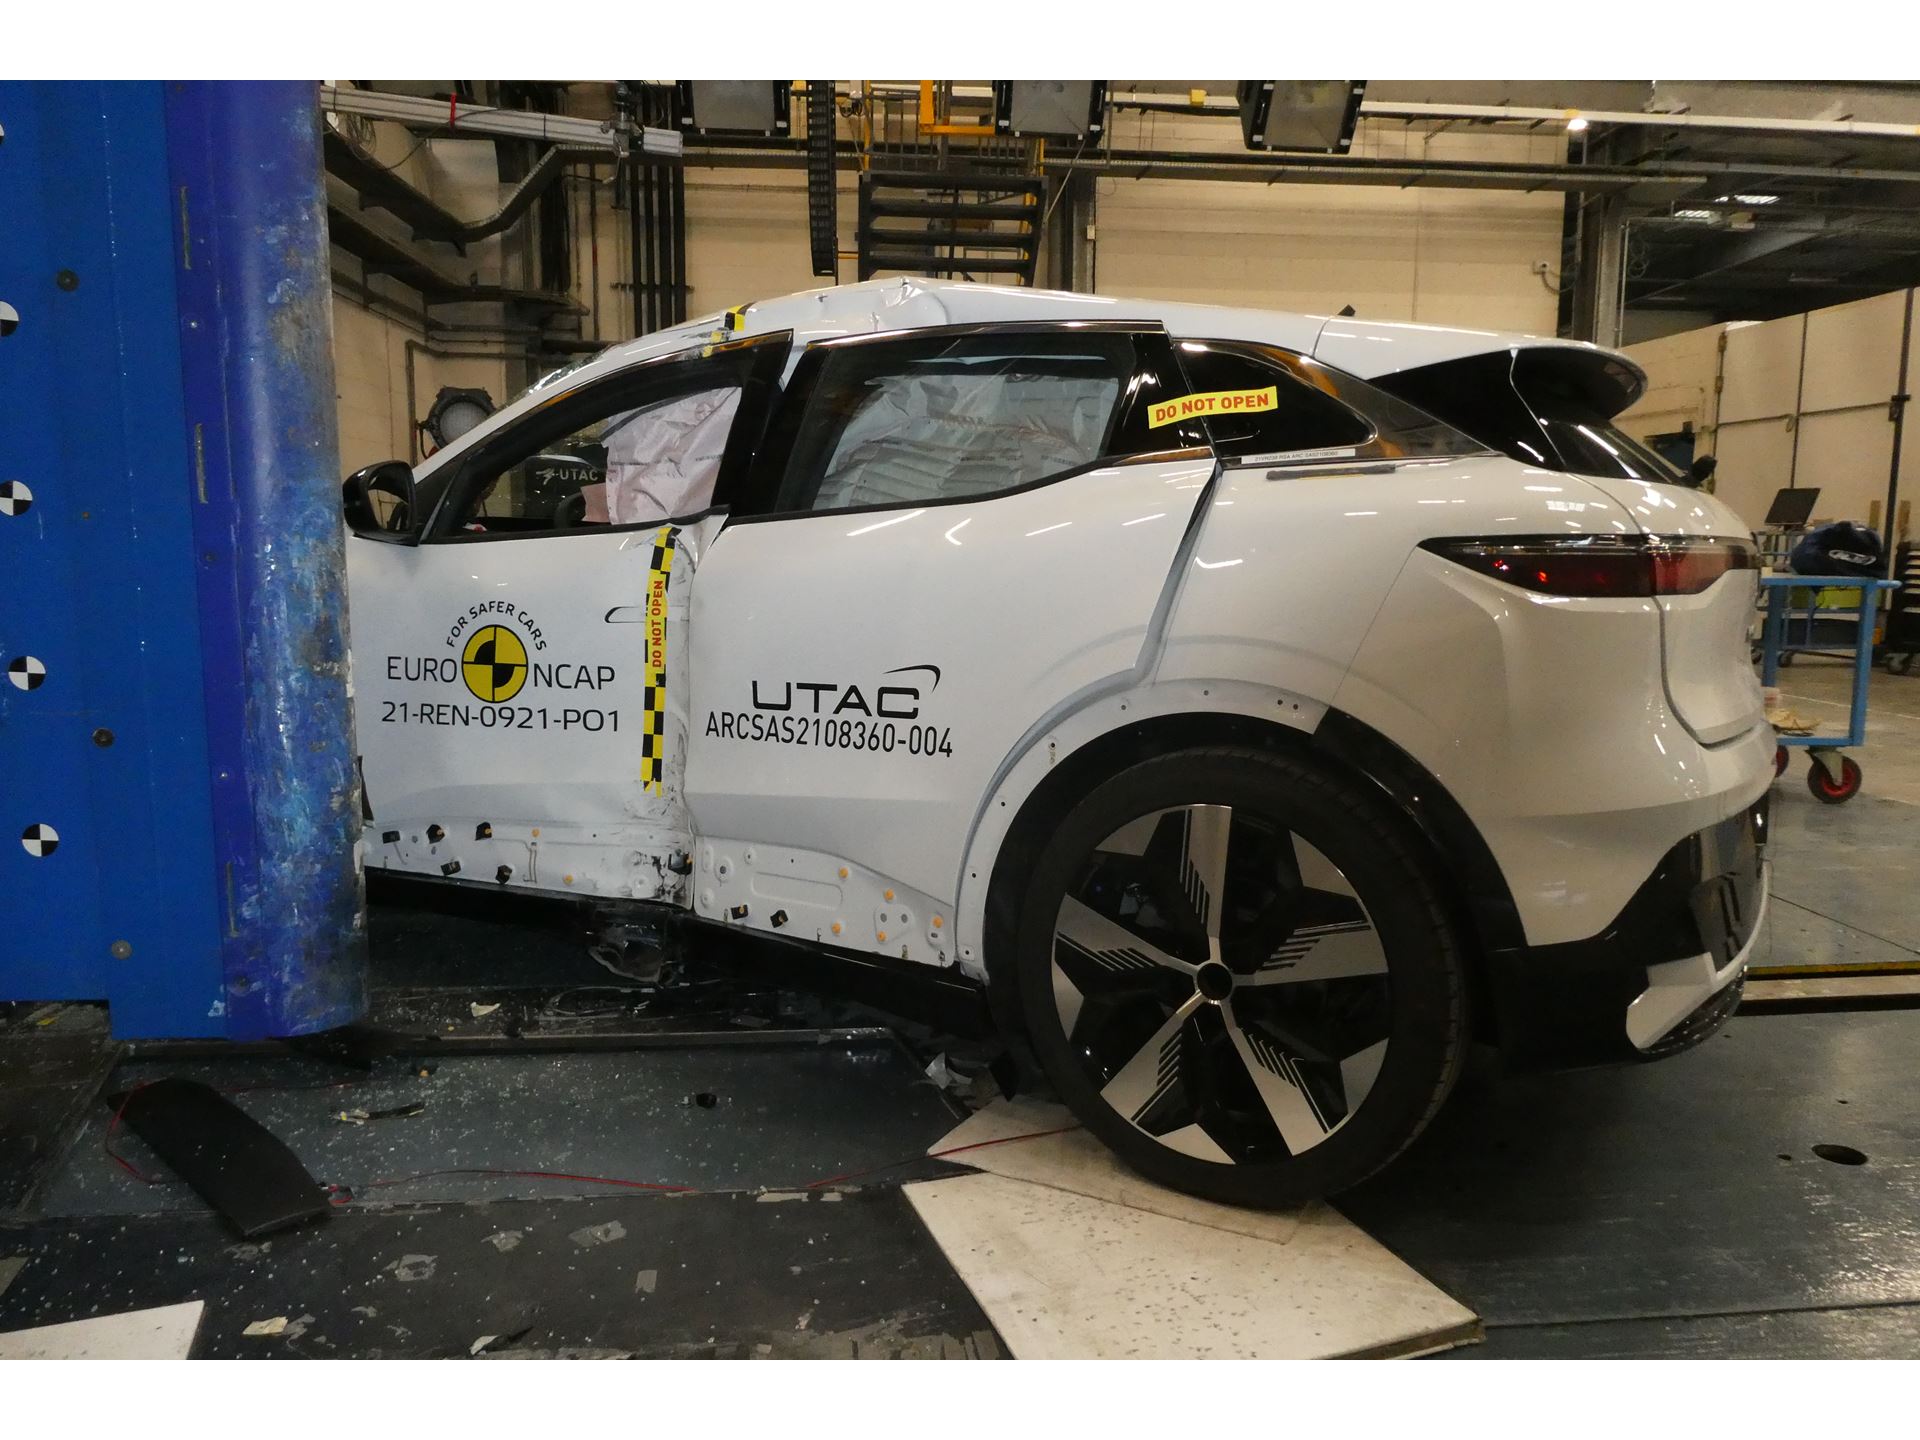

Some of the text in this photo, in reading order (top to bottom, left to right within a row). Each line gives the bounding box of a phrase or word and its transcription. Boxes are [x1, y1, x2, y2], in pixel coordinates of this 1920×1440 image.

[1155, 393, 1269, 422] DO NOT OPEN
[559, 468, 599, 482] UTAC
[446, 600, 547, 651] FOR SAFER CARS
[651, 580, 664, 668] DO NOT OPEN
[387, 656, 616, 690] EURO NCAP
[752, 680, 920, 720] UTAC
[705, 711, 953, 758] ARCSAS2108360-004
